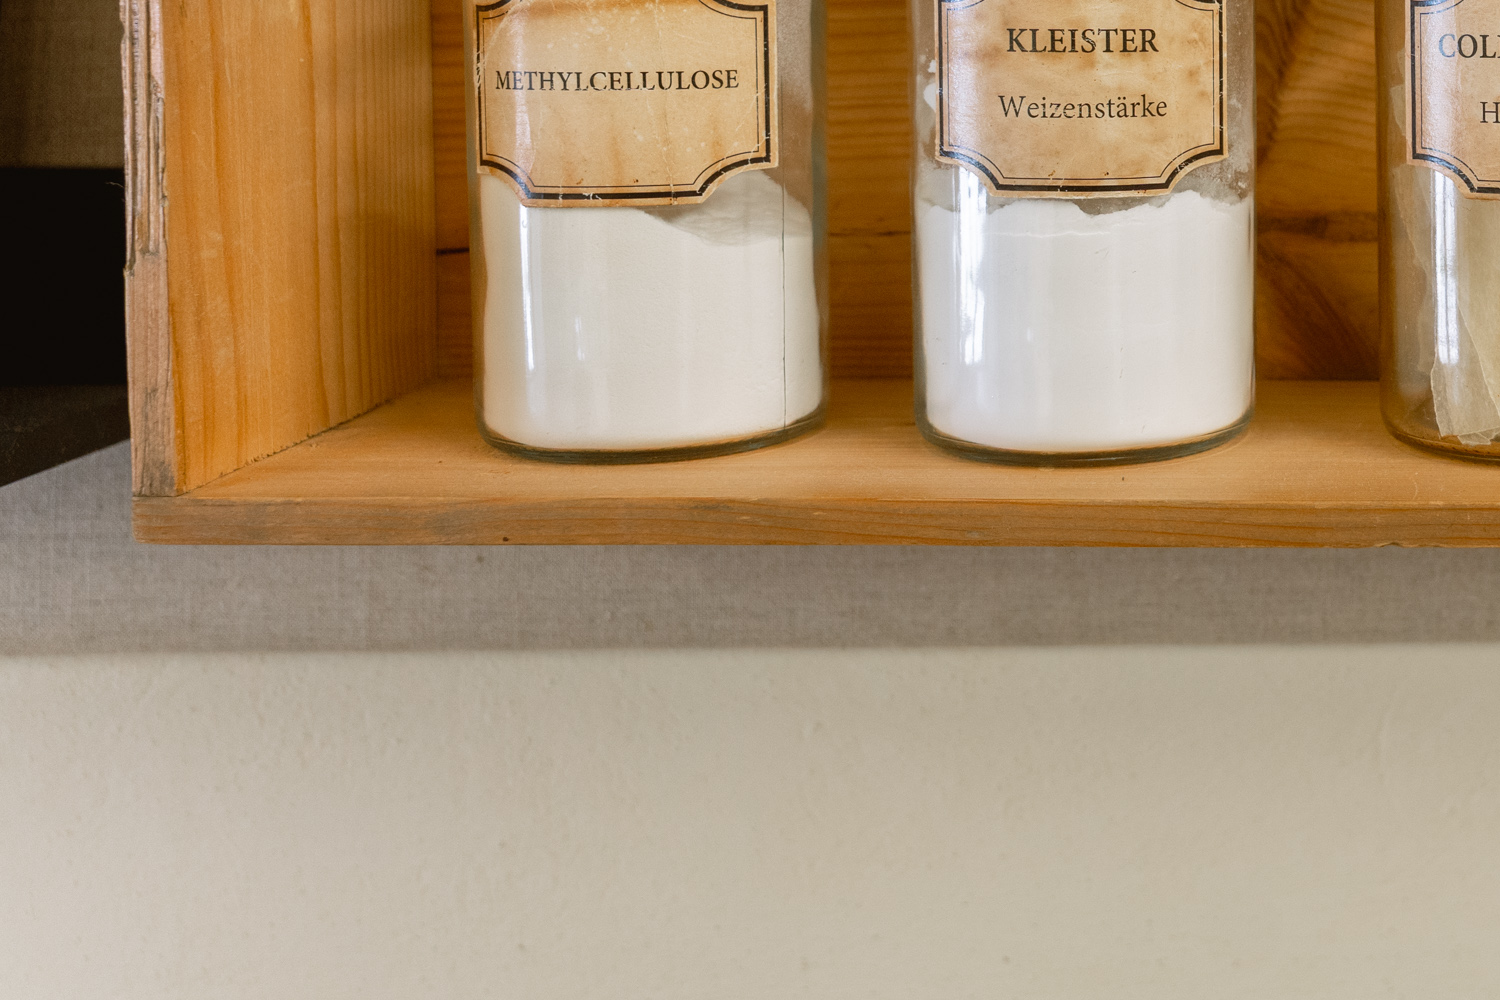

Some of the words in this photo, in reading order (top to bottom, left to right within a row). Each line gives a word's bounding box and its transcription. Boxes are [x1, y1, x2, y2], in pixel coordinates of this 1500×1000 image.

[1005, 27, 1160, 54] KLEISTER
[494, 68, 741, 92] METHYLCELLULOSE
[997, 94, 1169, 120] Weizenstärke
